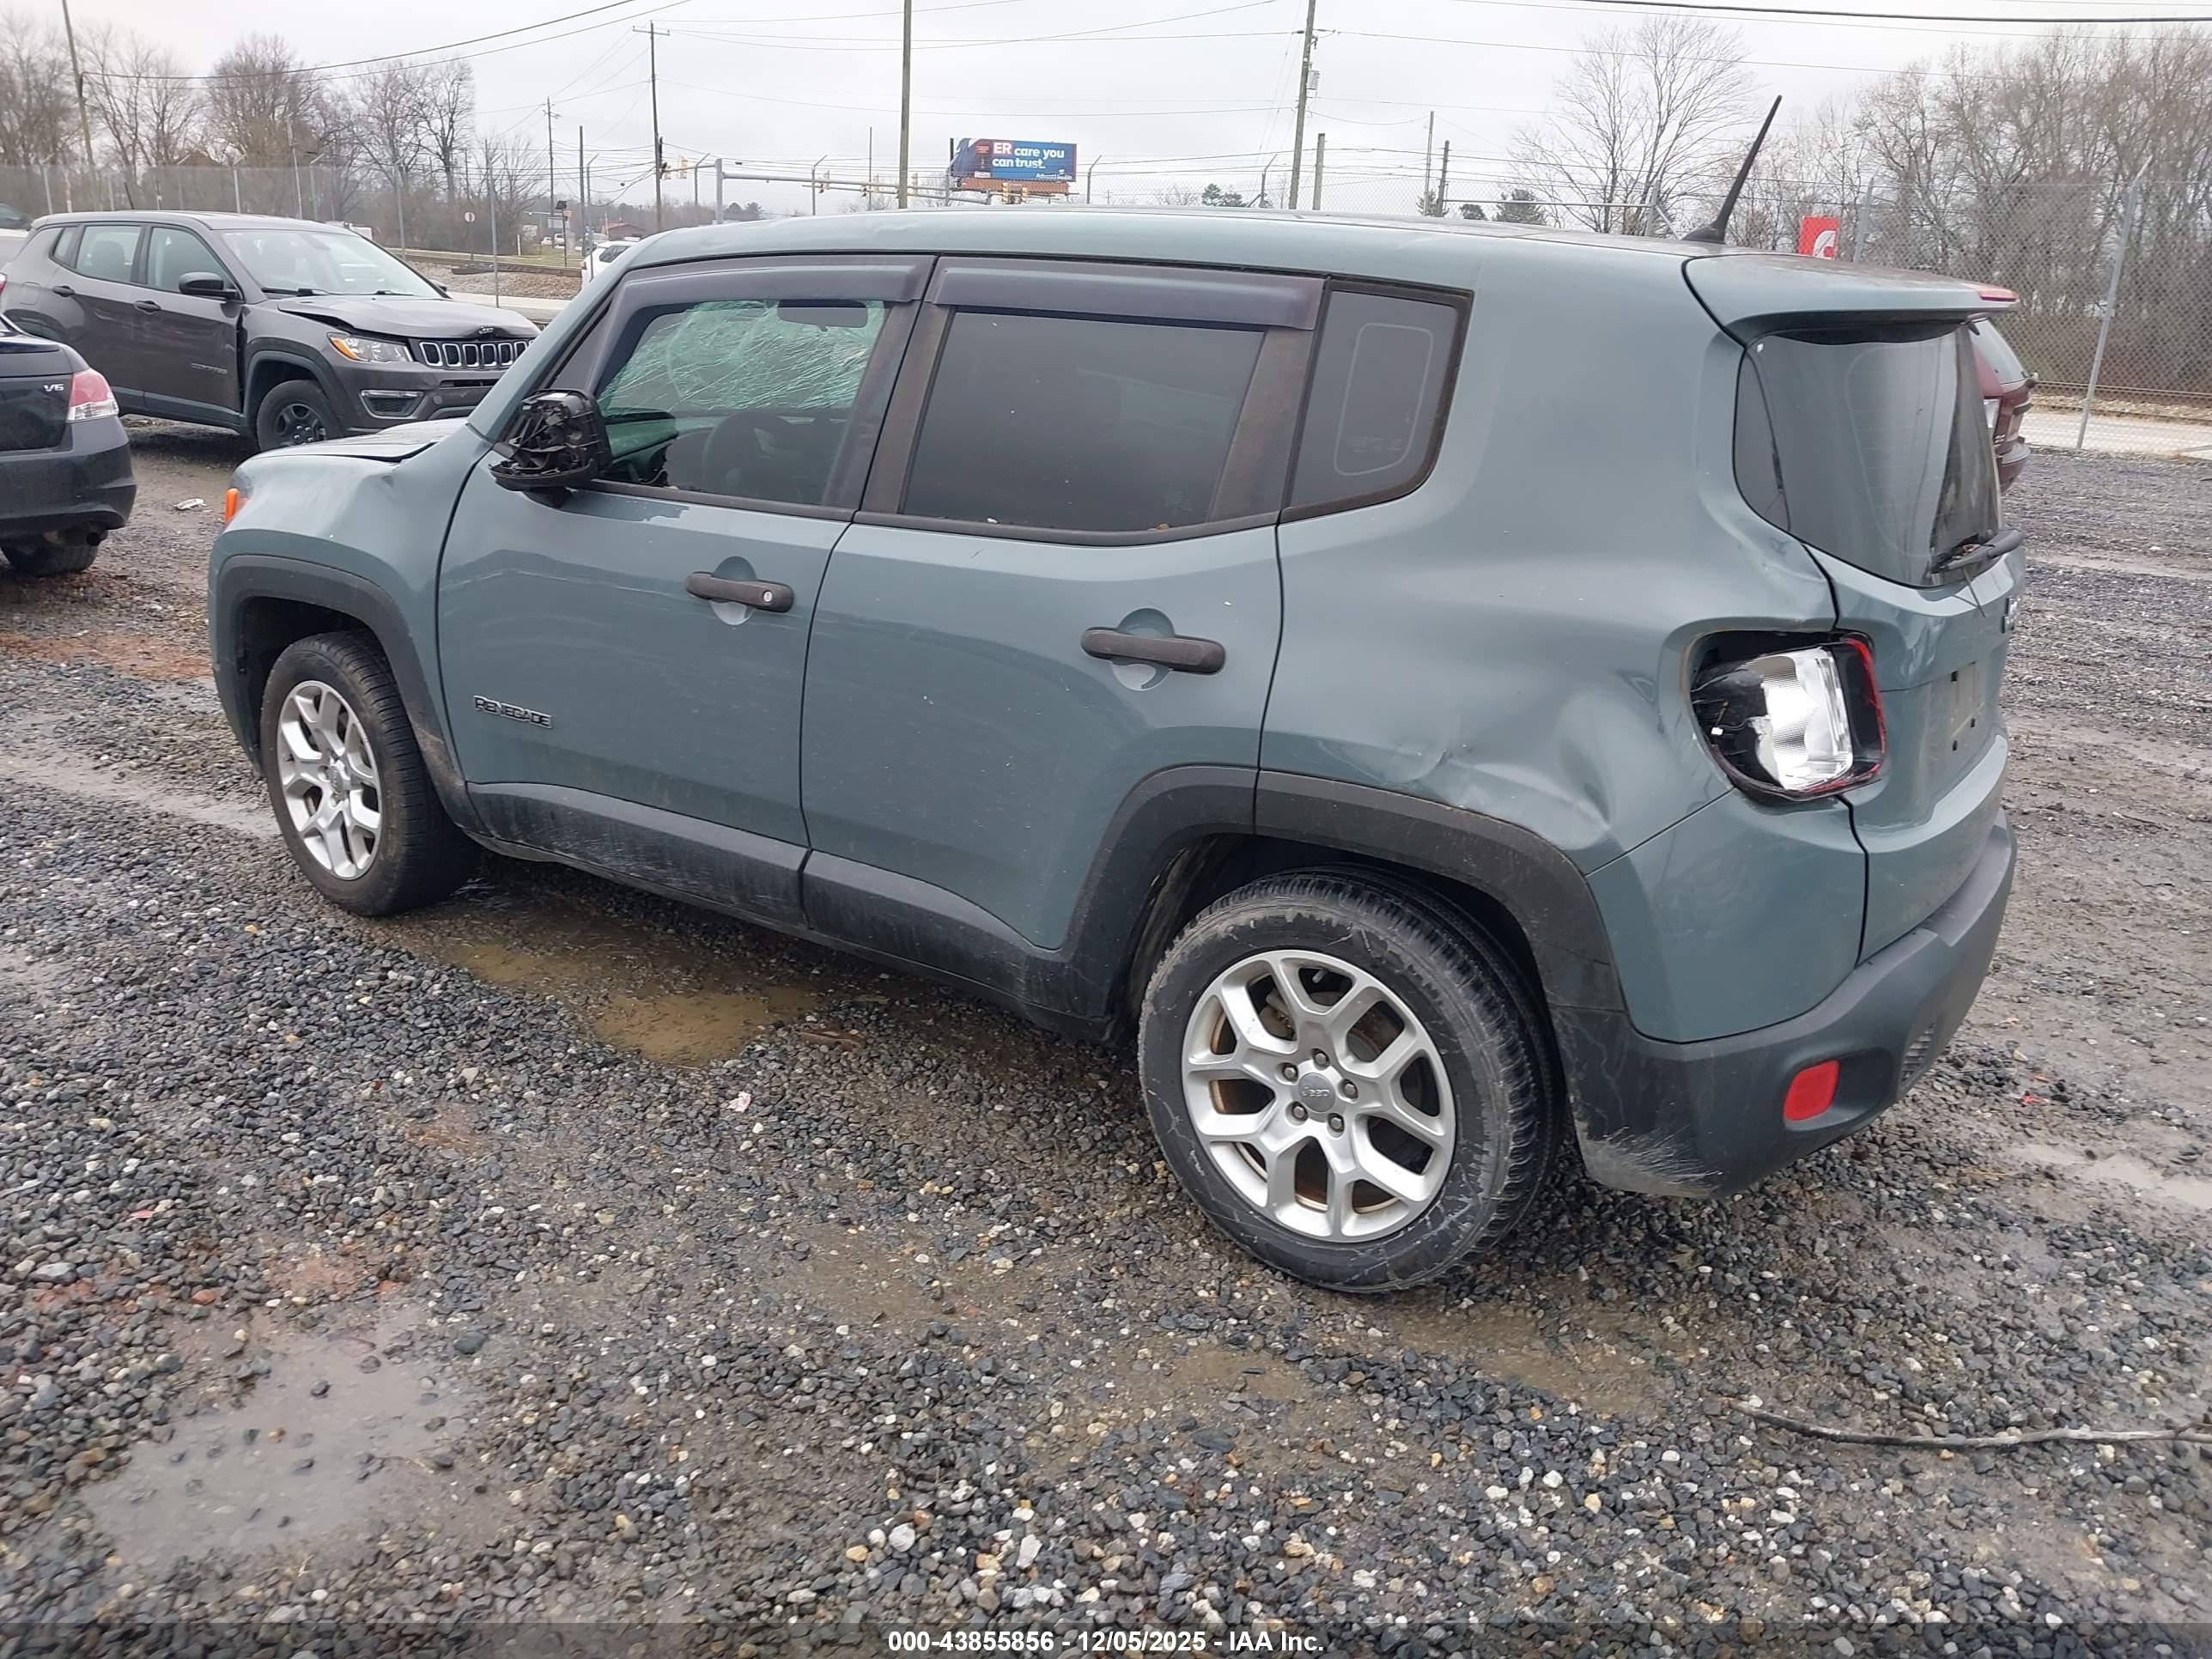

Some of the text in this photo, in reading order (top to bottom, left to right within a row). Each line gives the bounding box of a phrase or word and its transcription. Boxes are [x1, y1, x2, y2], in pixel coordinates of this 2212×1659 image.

[993, 143, 1012, 155] ER
[1014, 147, 1040, 157] care
[1043, 150, 1065, 160] you
[992, 158, 1014, 167] can
[473, 695, 553, 729] RENEGADE
